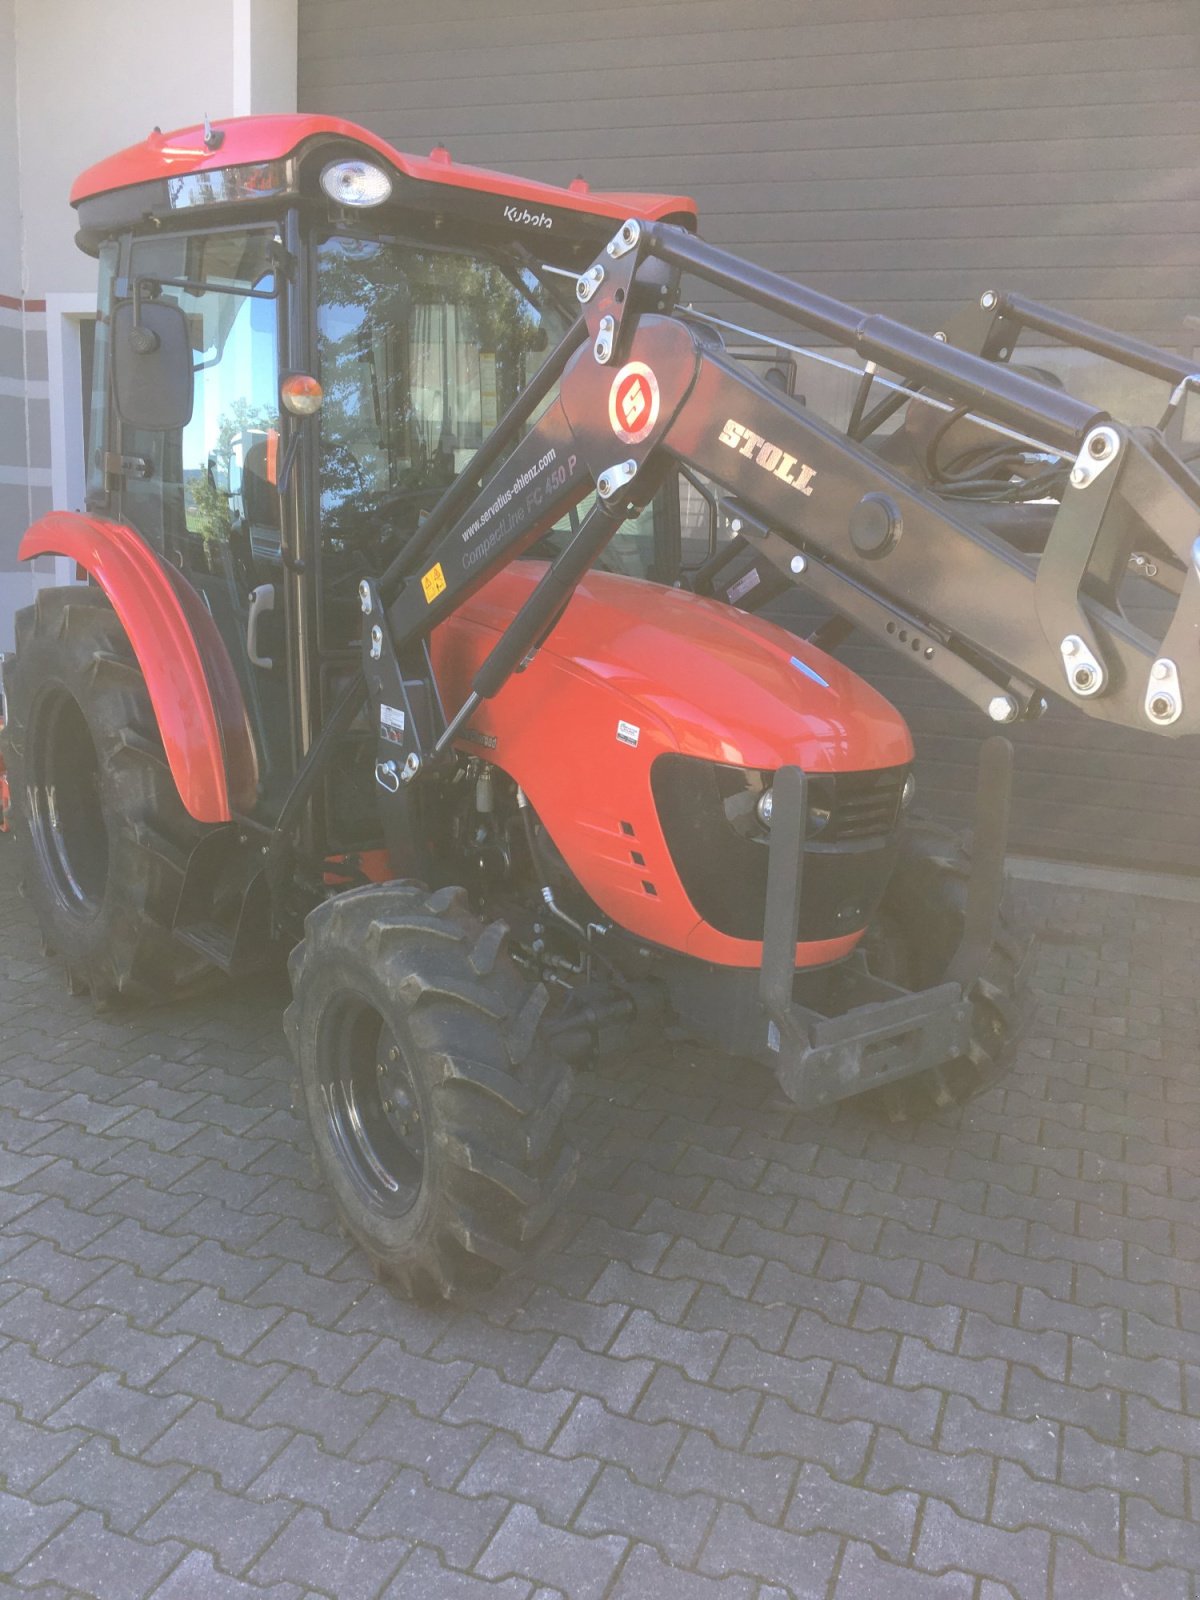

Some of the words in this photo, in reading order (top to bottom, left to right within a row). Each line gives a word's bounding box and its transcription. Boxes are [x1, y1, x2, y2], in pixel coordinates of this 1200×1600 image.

[503, 205, 553, 229] Kubota
[461, 448, 557, 542] www.servatius-ehlenz.com
[718, 419, 818, 497] STOLL
[462, 506, 525, 570] CompactLine
[525, 487, 543, 514] FC
[545, 465, 566, 495] 450
[567, 454, 577, 476] P
